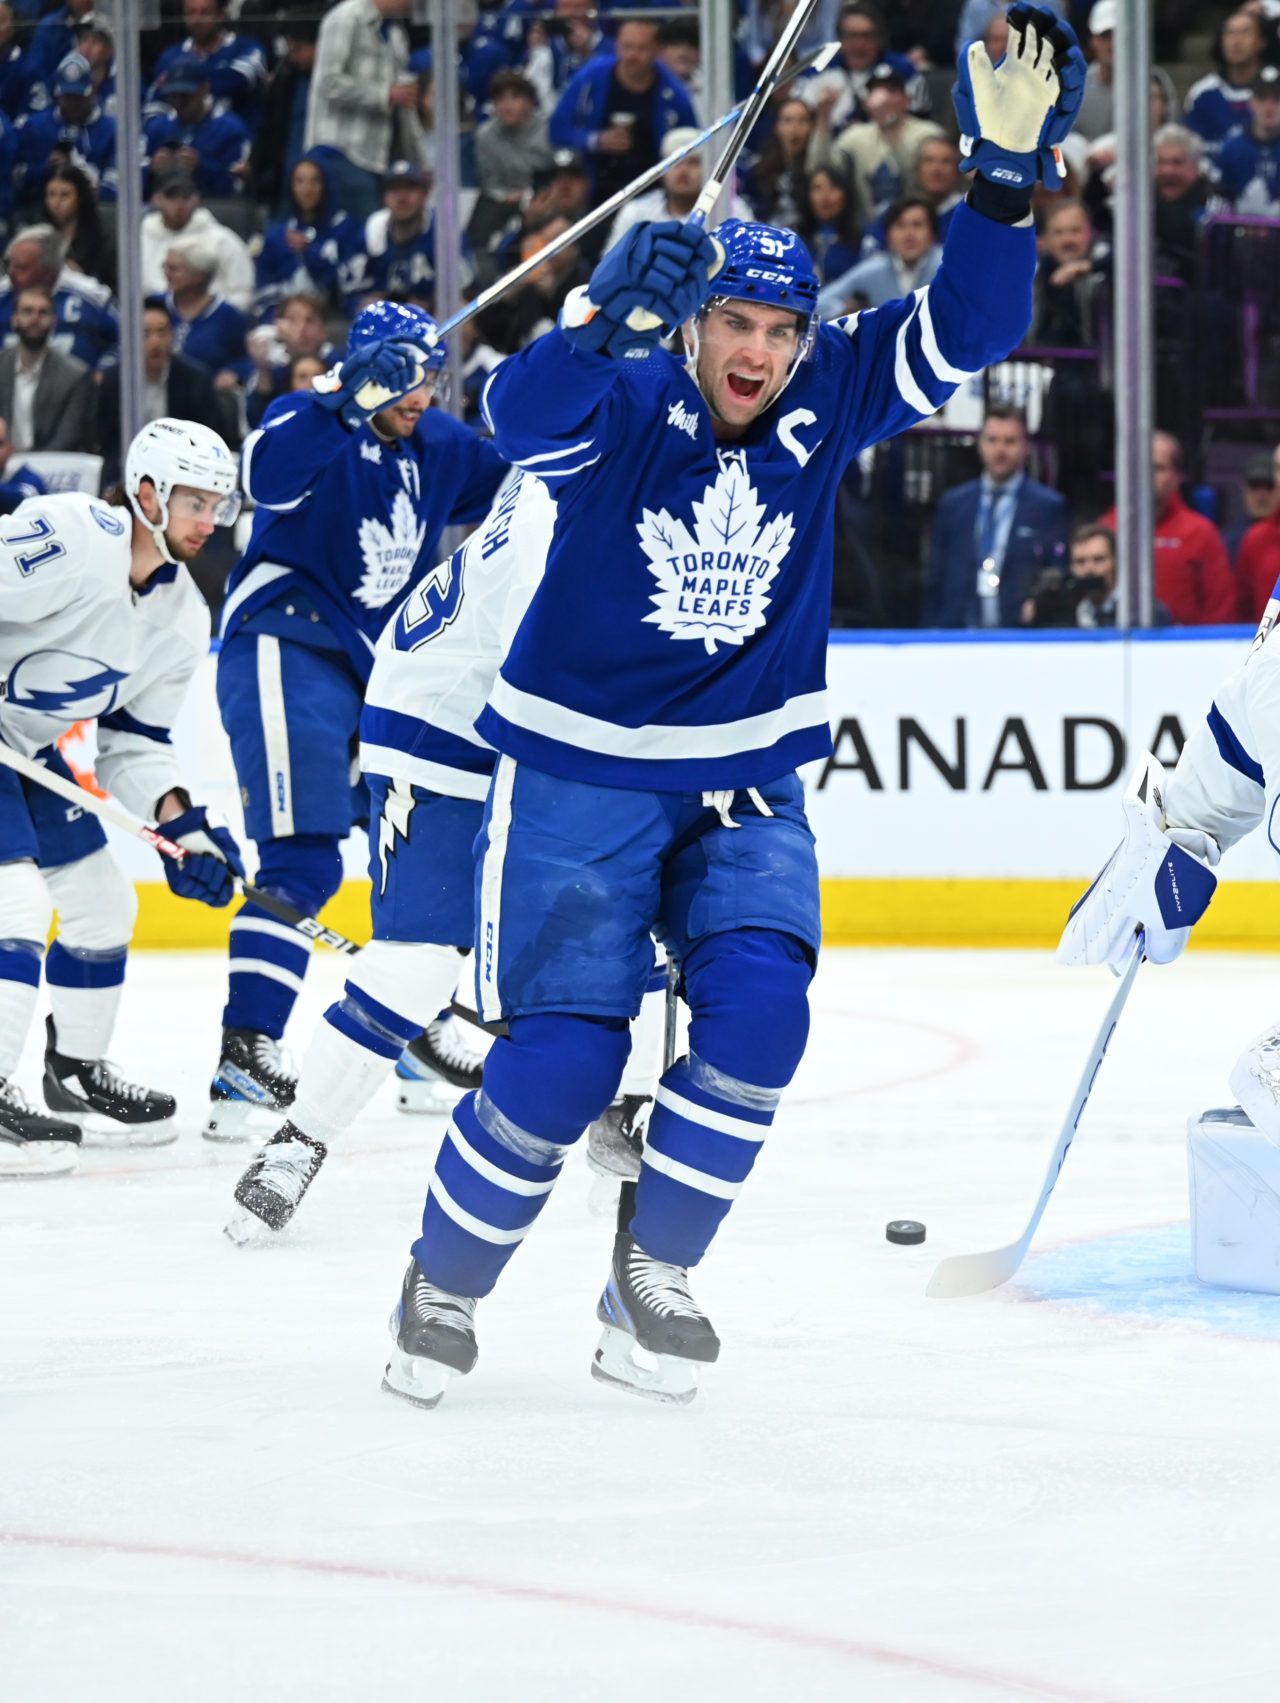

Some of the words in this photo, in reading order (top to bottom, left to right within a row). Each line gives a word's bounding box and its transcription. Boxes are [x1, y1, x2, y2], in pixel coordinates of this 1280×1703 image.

[746, 268, 793, 285] CCM
[776, 407, 823, 468] C
[1, 511, 67, 578] 71
[666, 551, 770, 579] TORONTO
[678, 595, 751, 616] LEAFS
[682, 576, 755, 596] MAPLE
[816, 714, 1189, 791] ANADA
[485, 921, 493, 983] CCM
